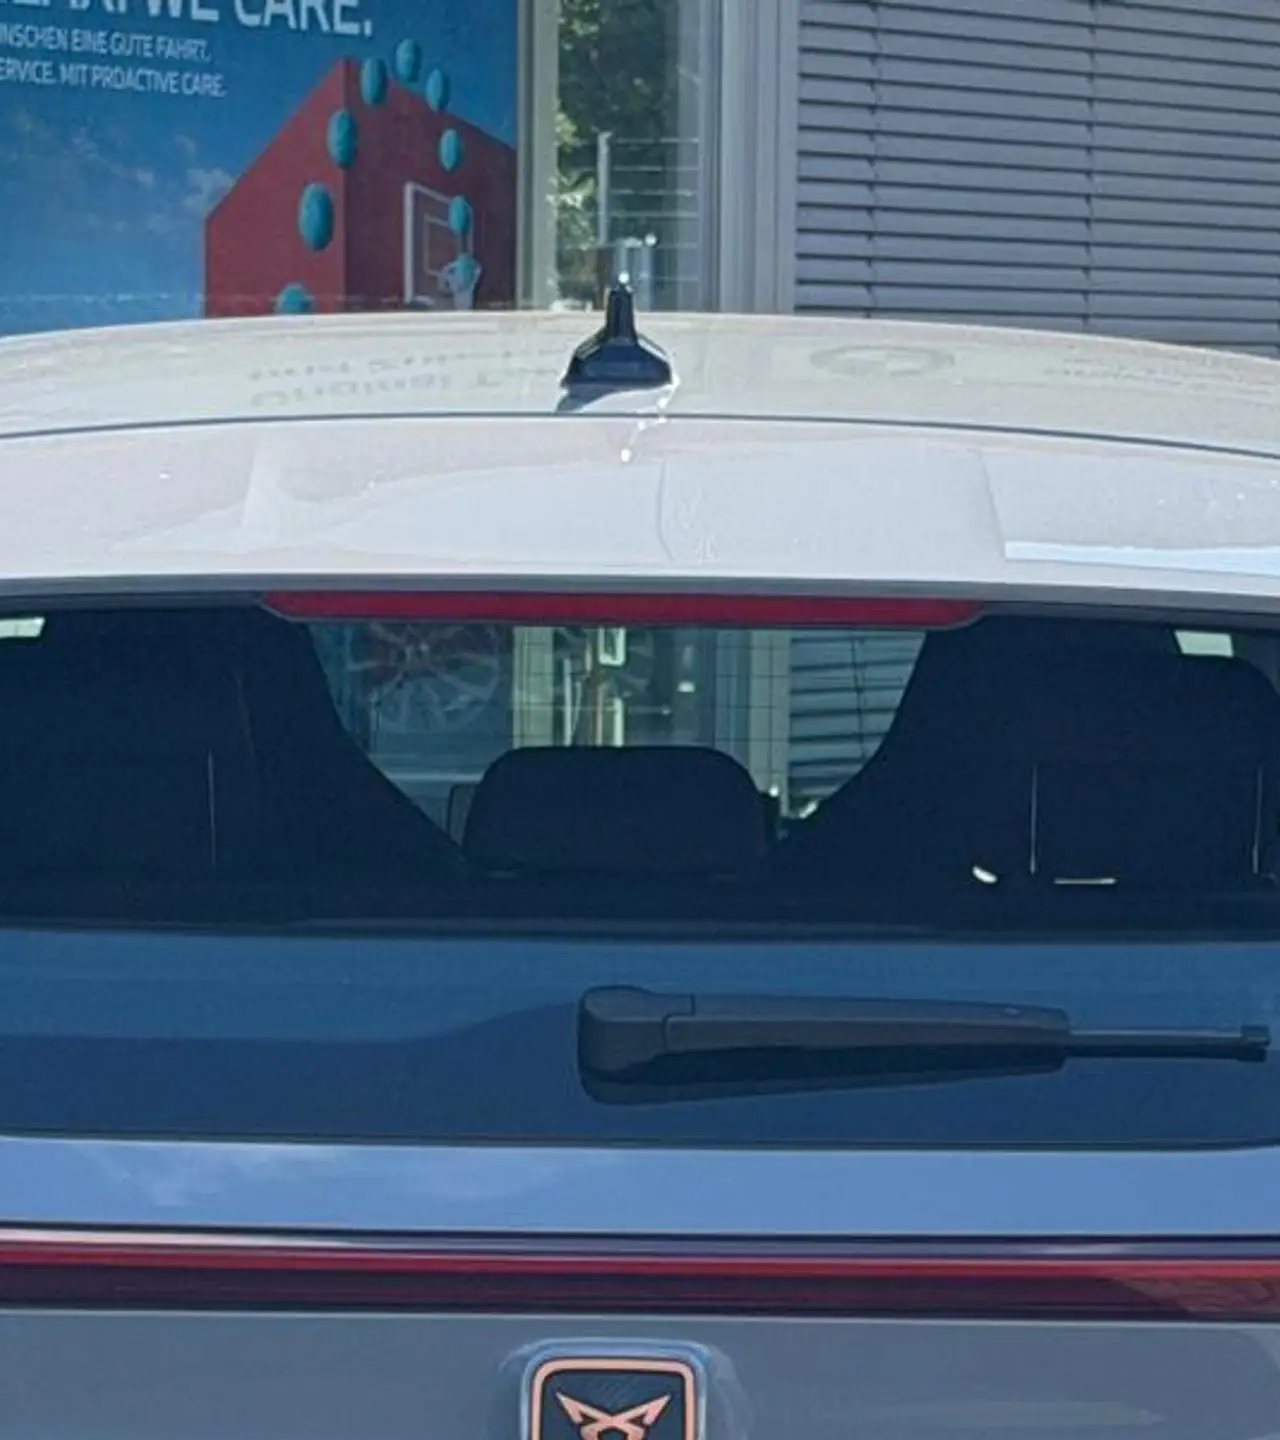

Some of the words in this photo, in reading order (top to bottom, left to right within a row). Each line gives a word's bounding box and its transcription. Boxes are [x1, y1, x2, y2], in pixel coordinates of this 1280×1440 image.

[70, 28, 108, 54] EINE
[109, 31, 154, 57] GUTE
[59, 62, 87, 86] MIT
[90, 64, 180, 94] PROACTIVE
